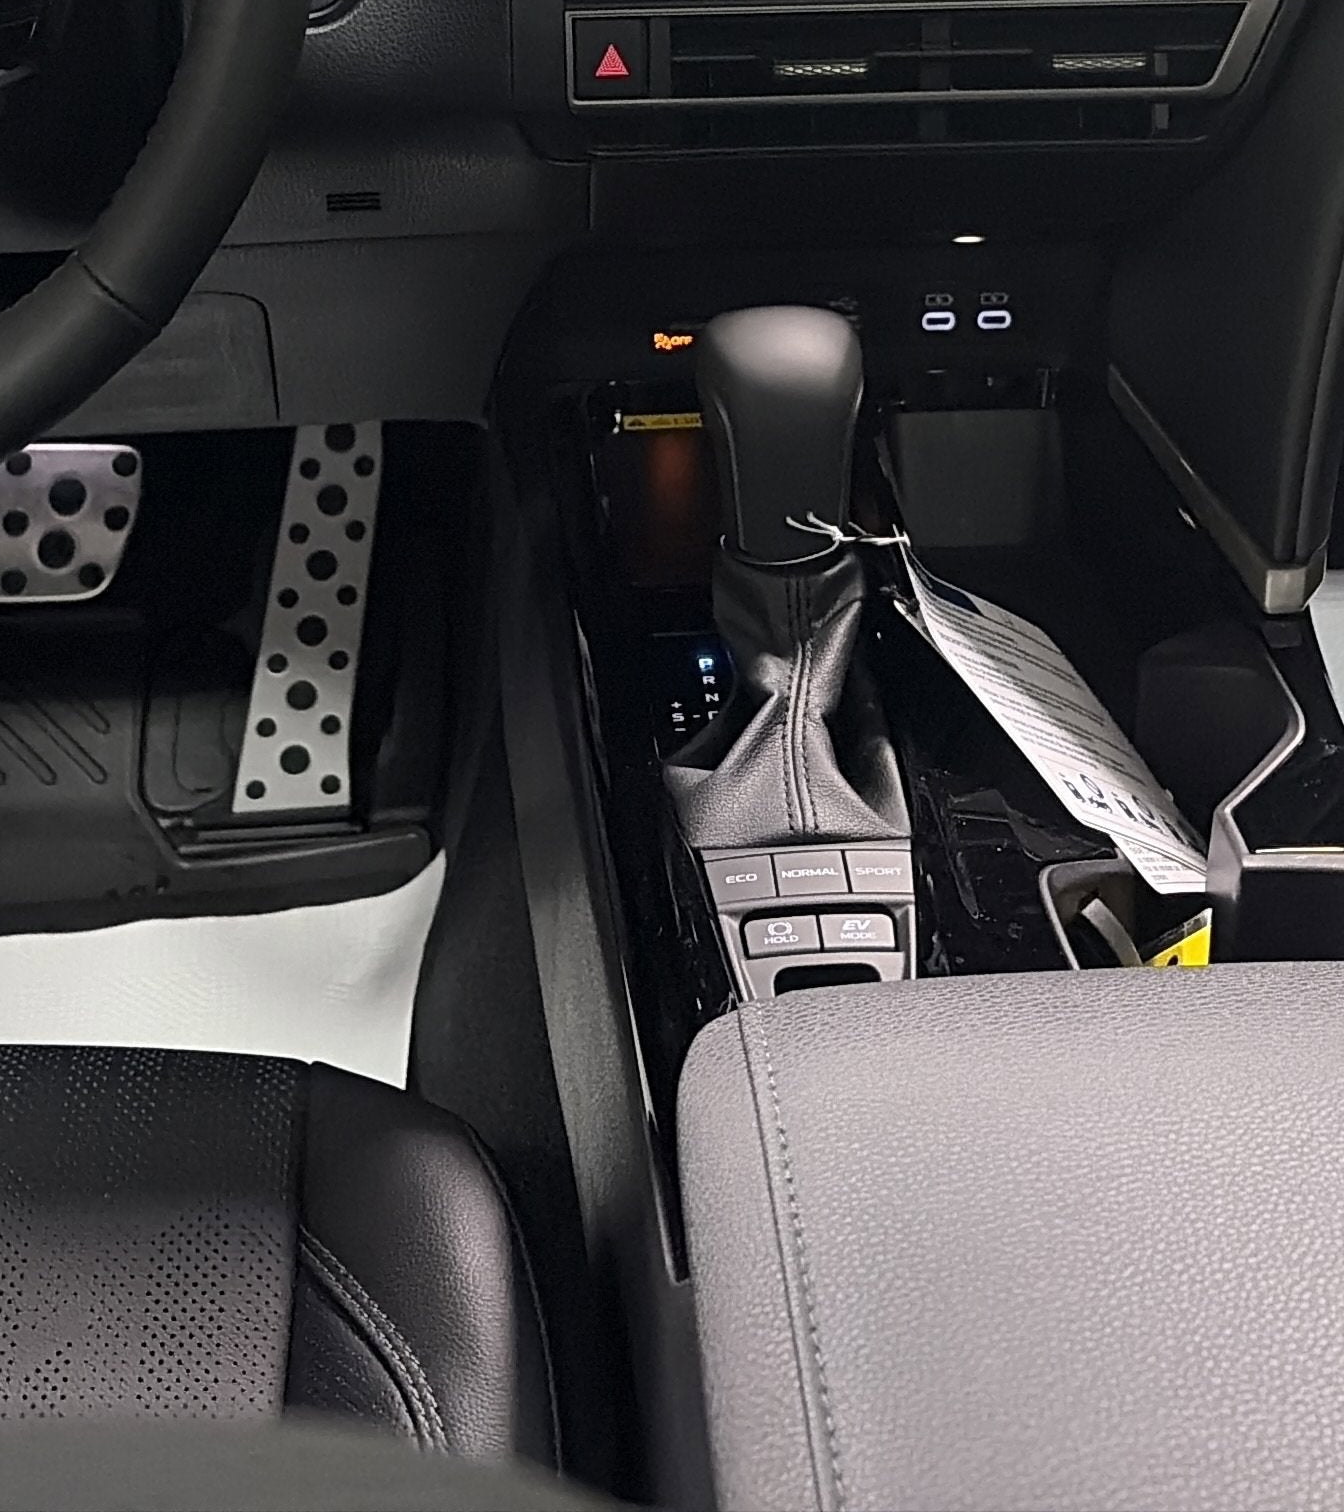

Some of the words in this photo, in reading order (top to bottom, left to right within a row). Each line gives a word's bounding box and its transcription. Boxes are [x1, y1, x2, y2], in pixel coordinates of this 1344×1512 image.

[698, 658, 714, 671] P
[702, 676, 716, 685] R
[705, 693, 720, 702] N
[672, 713, 685, 722] S
[781, 867, 839, 879] NORMAL
[856, 867, 903, 876] SPORT
[725, 873, 758, 884] ECO
[842, 919, 872, 931] EV
[764, 934, 799, 945] HOLD
[840, 932, 876, 941] MODE
